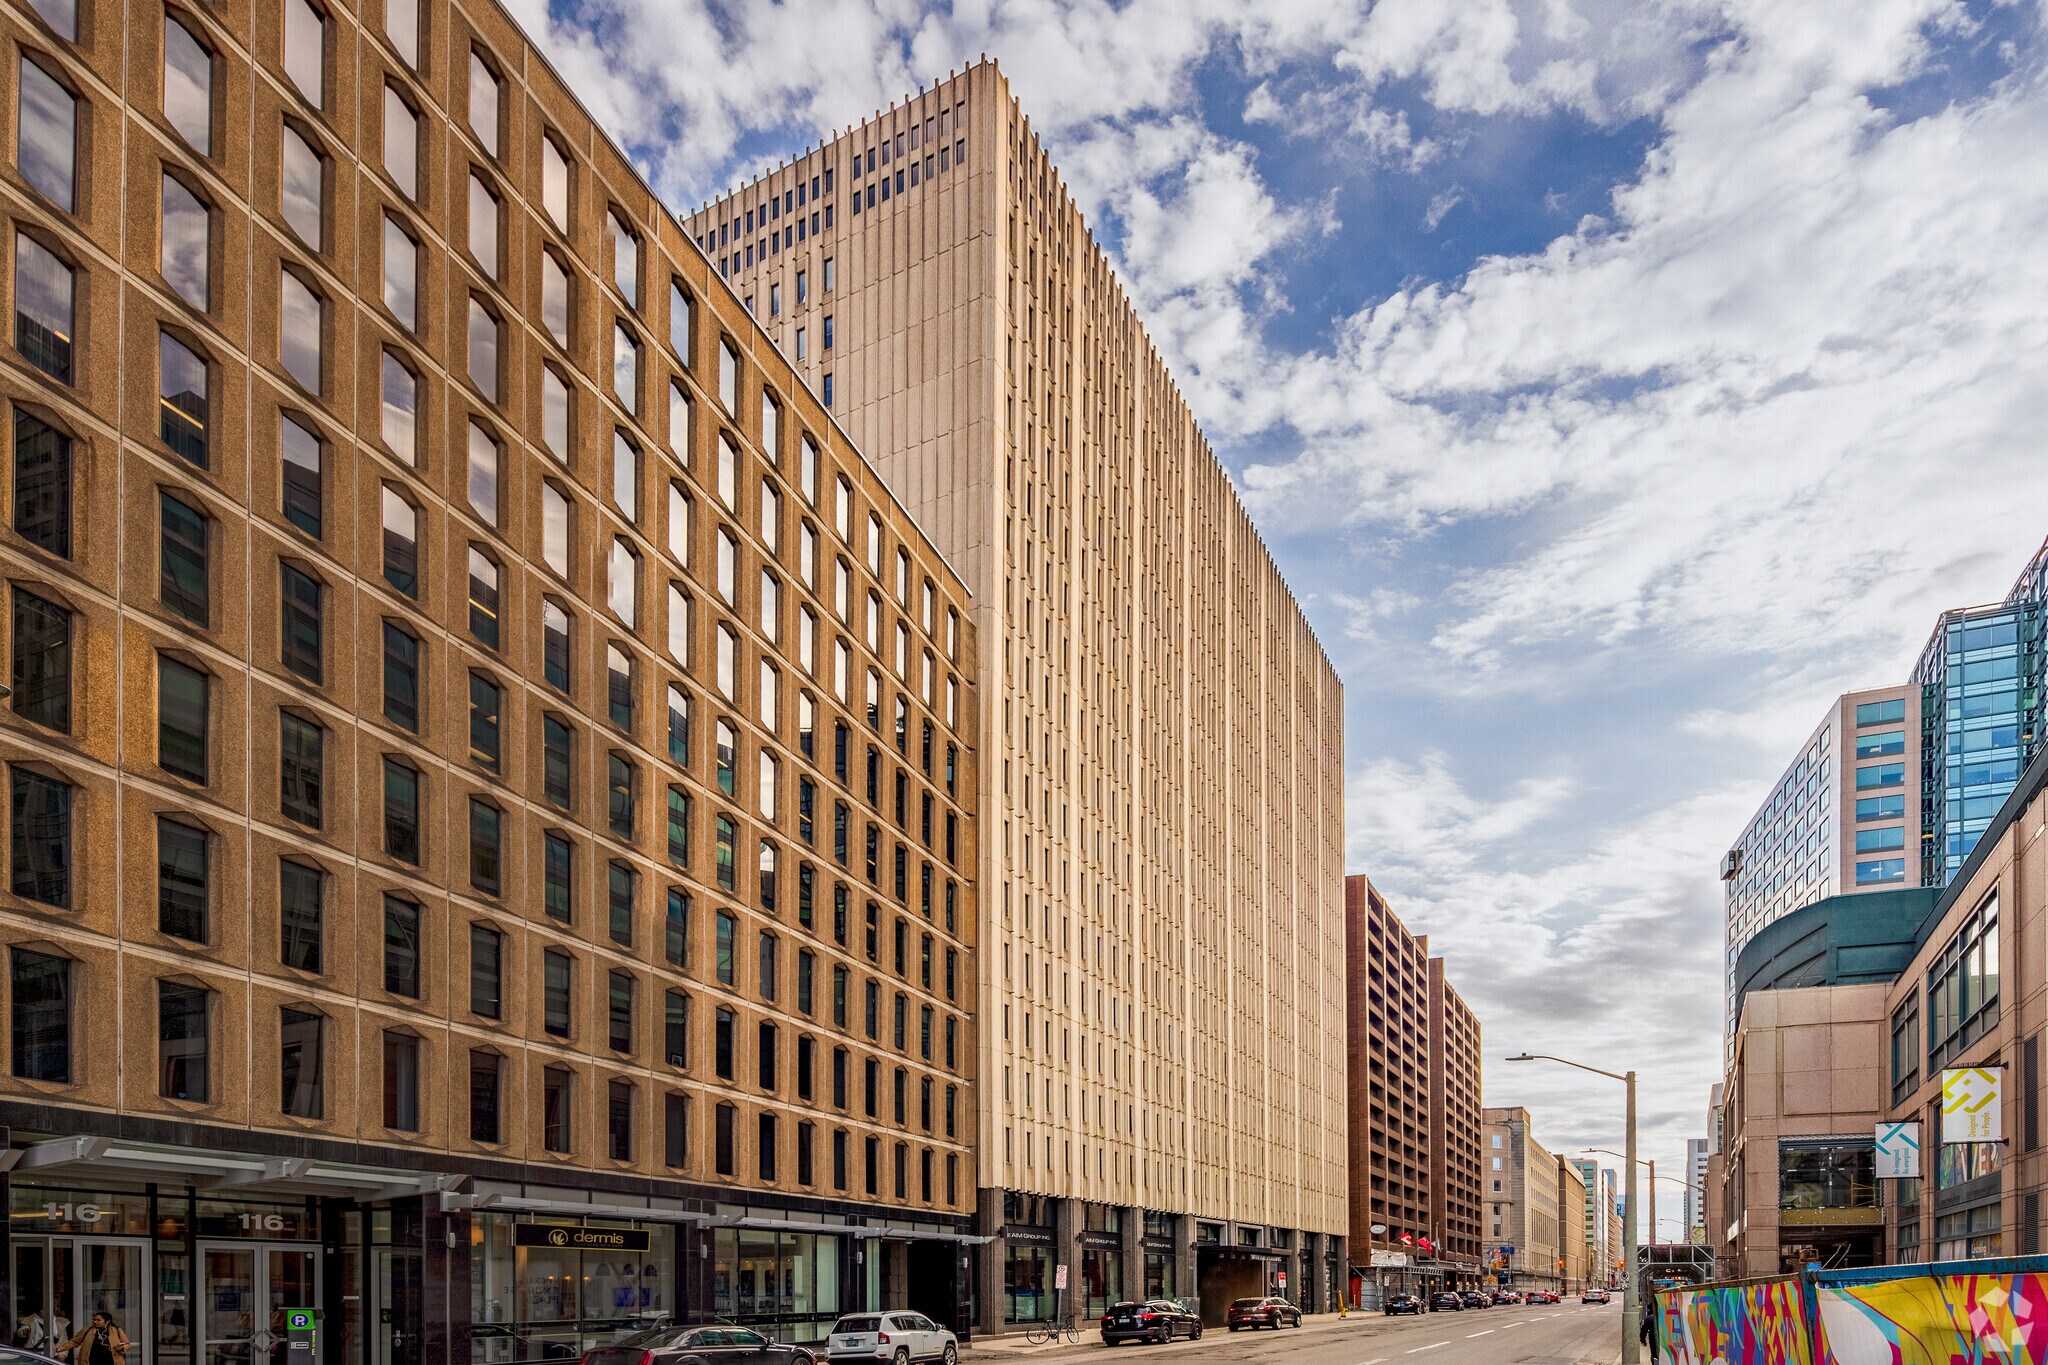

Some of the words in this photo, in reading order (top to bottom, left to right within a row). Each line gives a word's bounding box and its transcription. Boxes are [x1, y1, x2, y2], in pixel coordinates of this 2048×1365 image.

[1968, 1115, 1978, 1137] Designed
[1981, 1129, 1990, 1137] for
[43, 1202, 102, 1222] 116
[238, 1213, 284, 1231] 116
[573, 1229, 624, 1244] dermis
